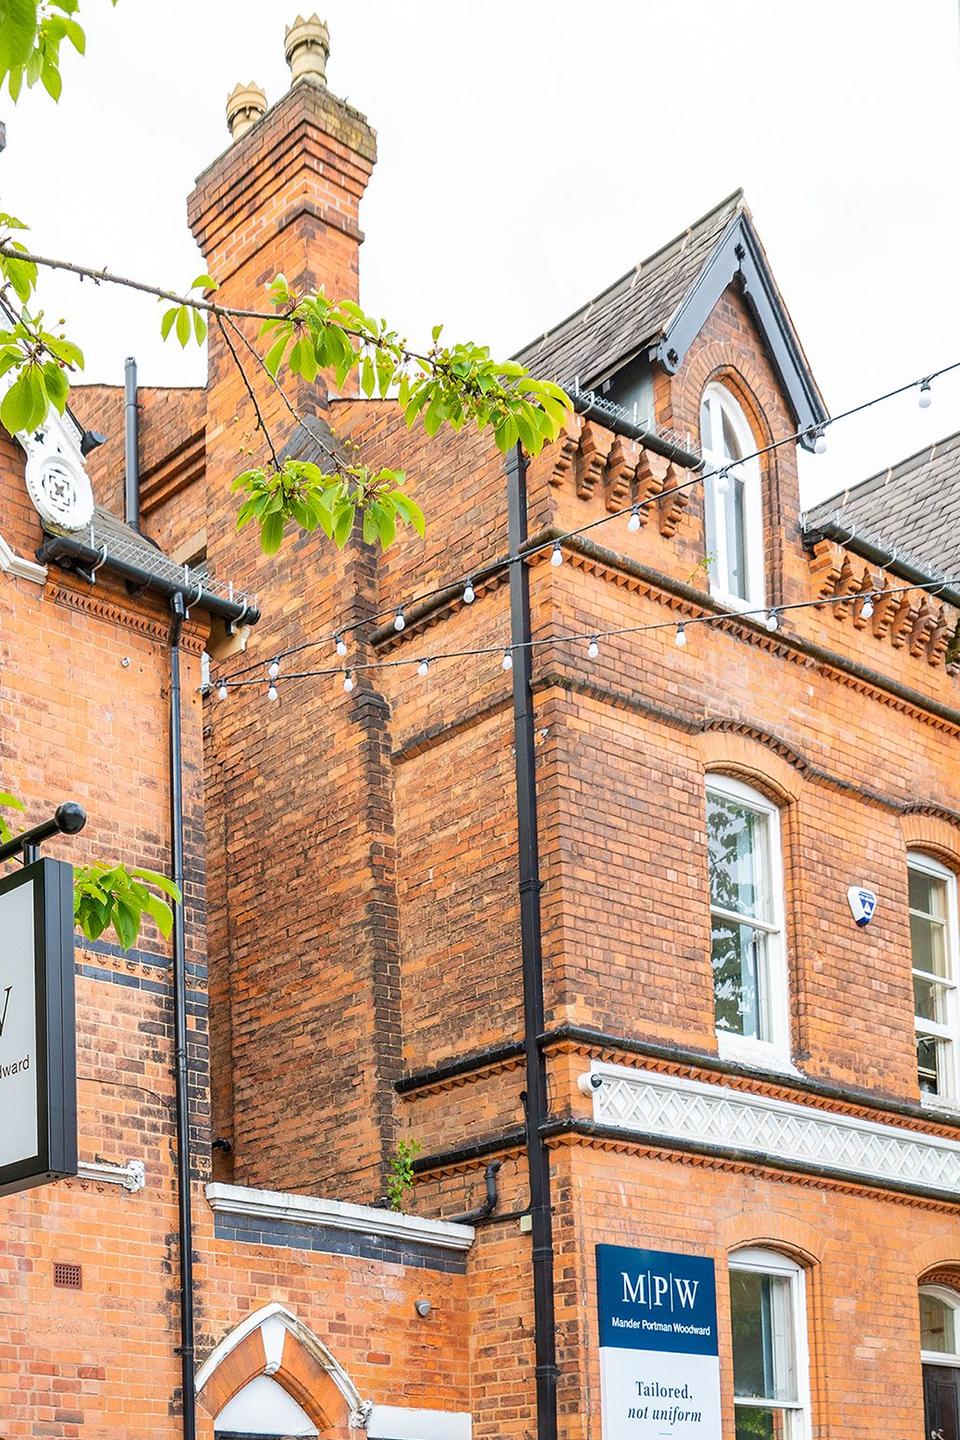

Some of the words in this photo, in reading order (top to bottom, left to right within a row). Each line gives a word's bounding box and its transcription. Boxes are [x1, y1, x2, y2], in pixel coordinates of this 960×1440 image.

[612, 1316, 640, 1330] Mander
[642, 1320, 672, 1332] Portman
[674, 1323, 710, 1336] Woodward
[635, 1381, 693, 1399] Tailored.
[628, 1406, 648, 1420] not
[652, 1406, 702, 1425] uniform
